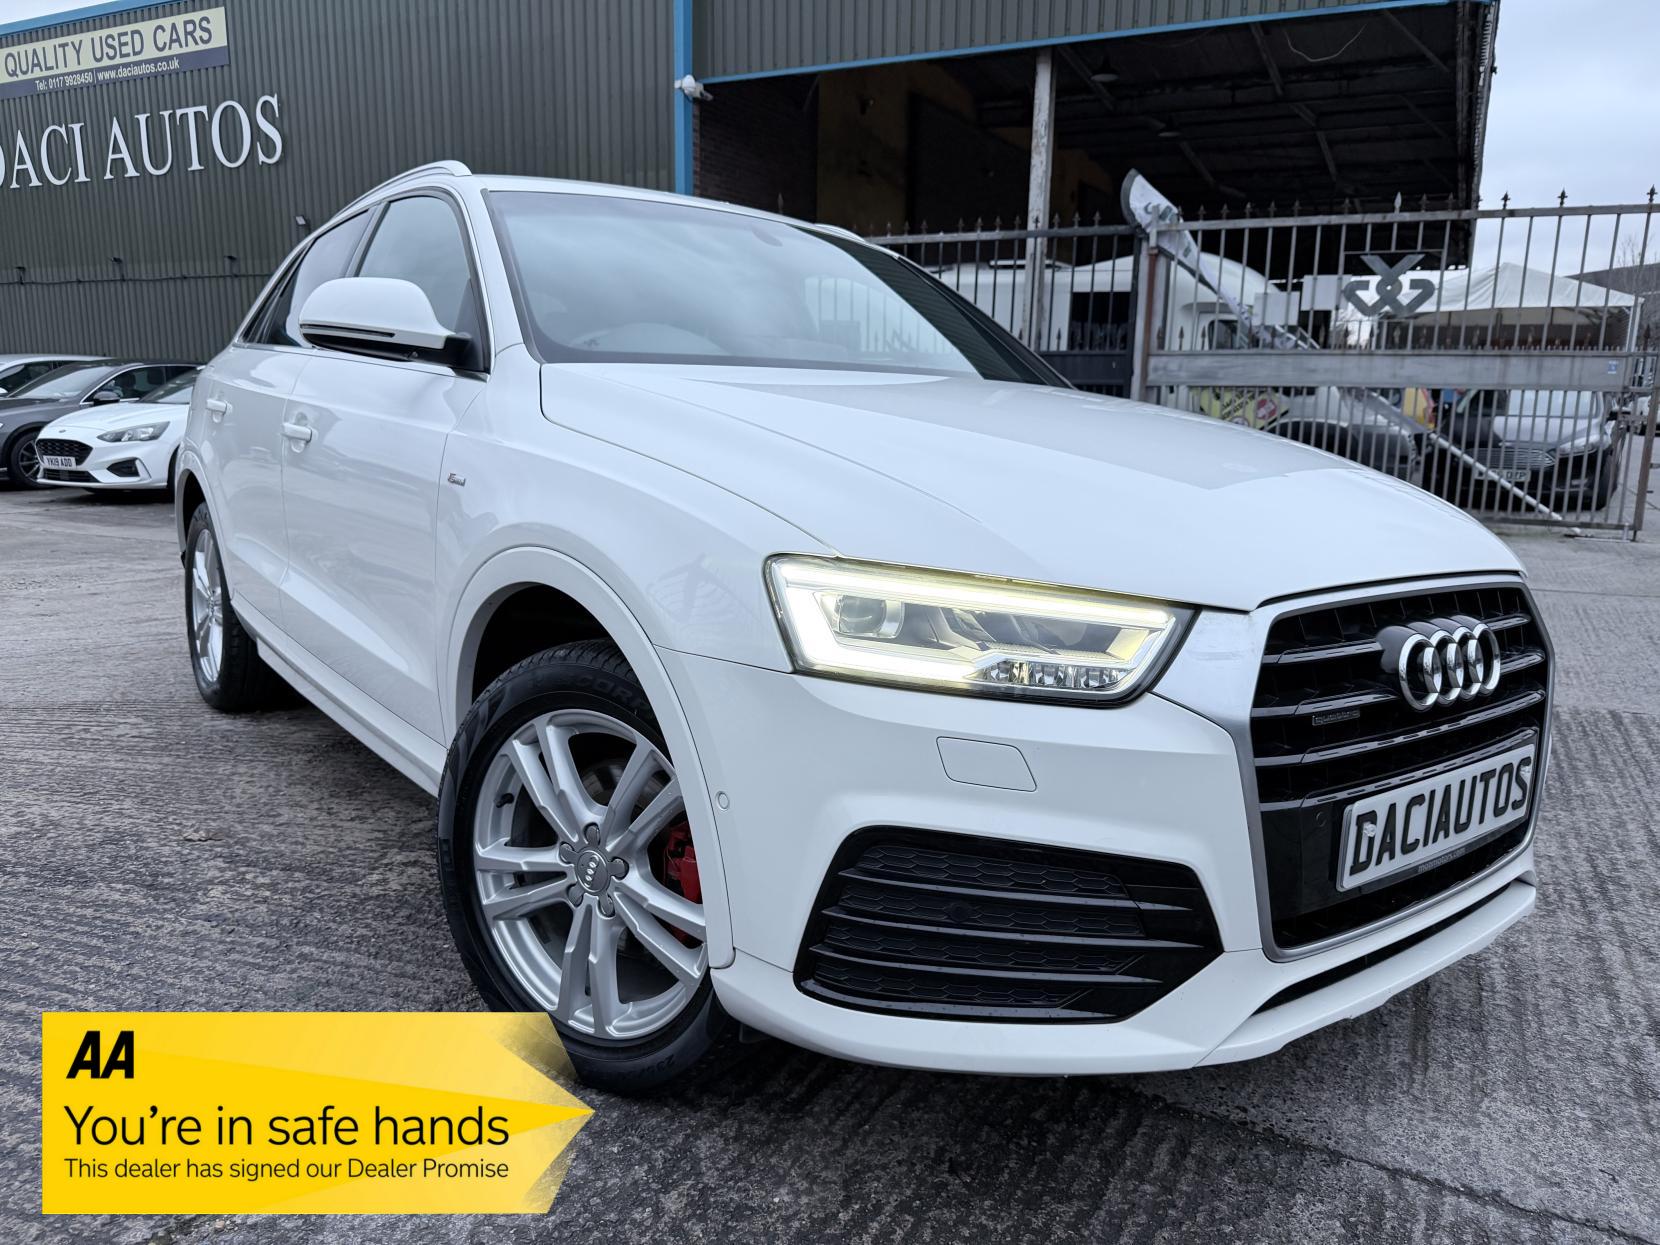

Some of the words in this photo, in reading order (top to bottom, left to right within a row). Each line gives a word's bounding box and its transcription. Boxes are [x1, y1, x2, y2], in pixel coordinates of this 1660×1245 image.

[5, 40, 83, 78] QUALITY
[91, 29, 145, 63] USED
[153, 16, 213, 51] CARS
[35, 80, 48, 91] Tel:
[48, 76, 64, 89] 0117
[97, 57, 180, 81] www.daciautos.co.uk
[0, 122, 91, 189] ACI
[103, 93, 283, 181] AUTOS
[1350, 756, 1532, 876] DACIAUTOS
